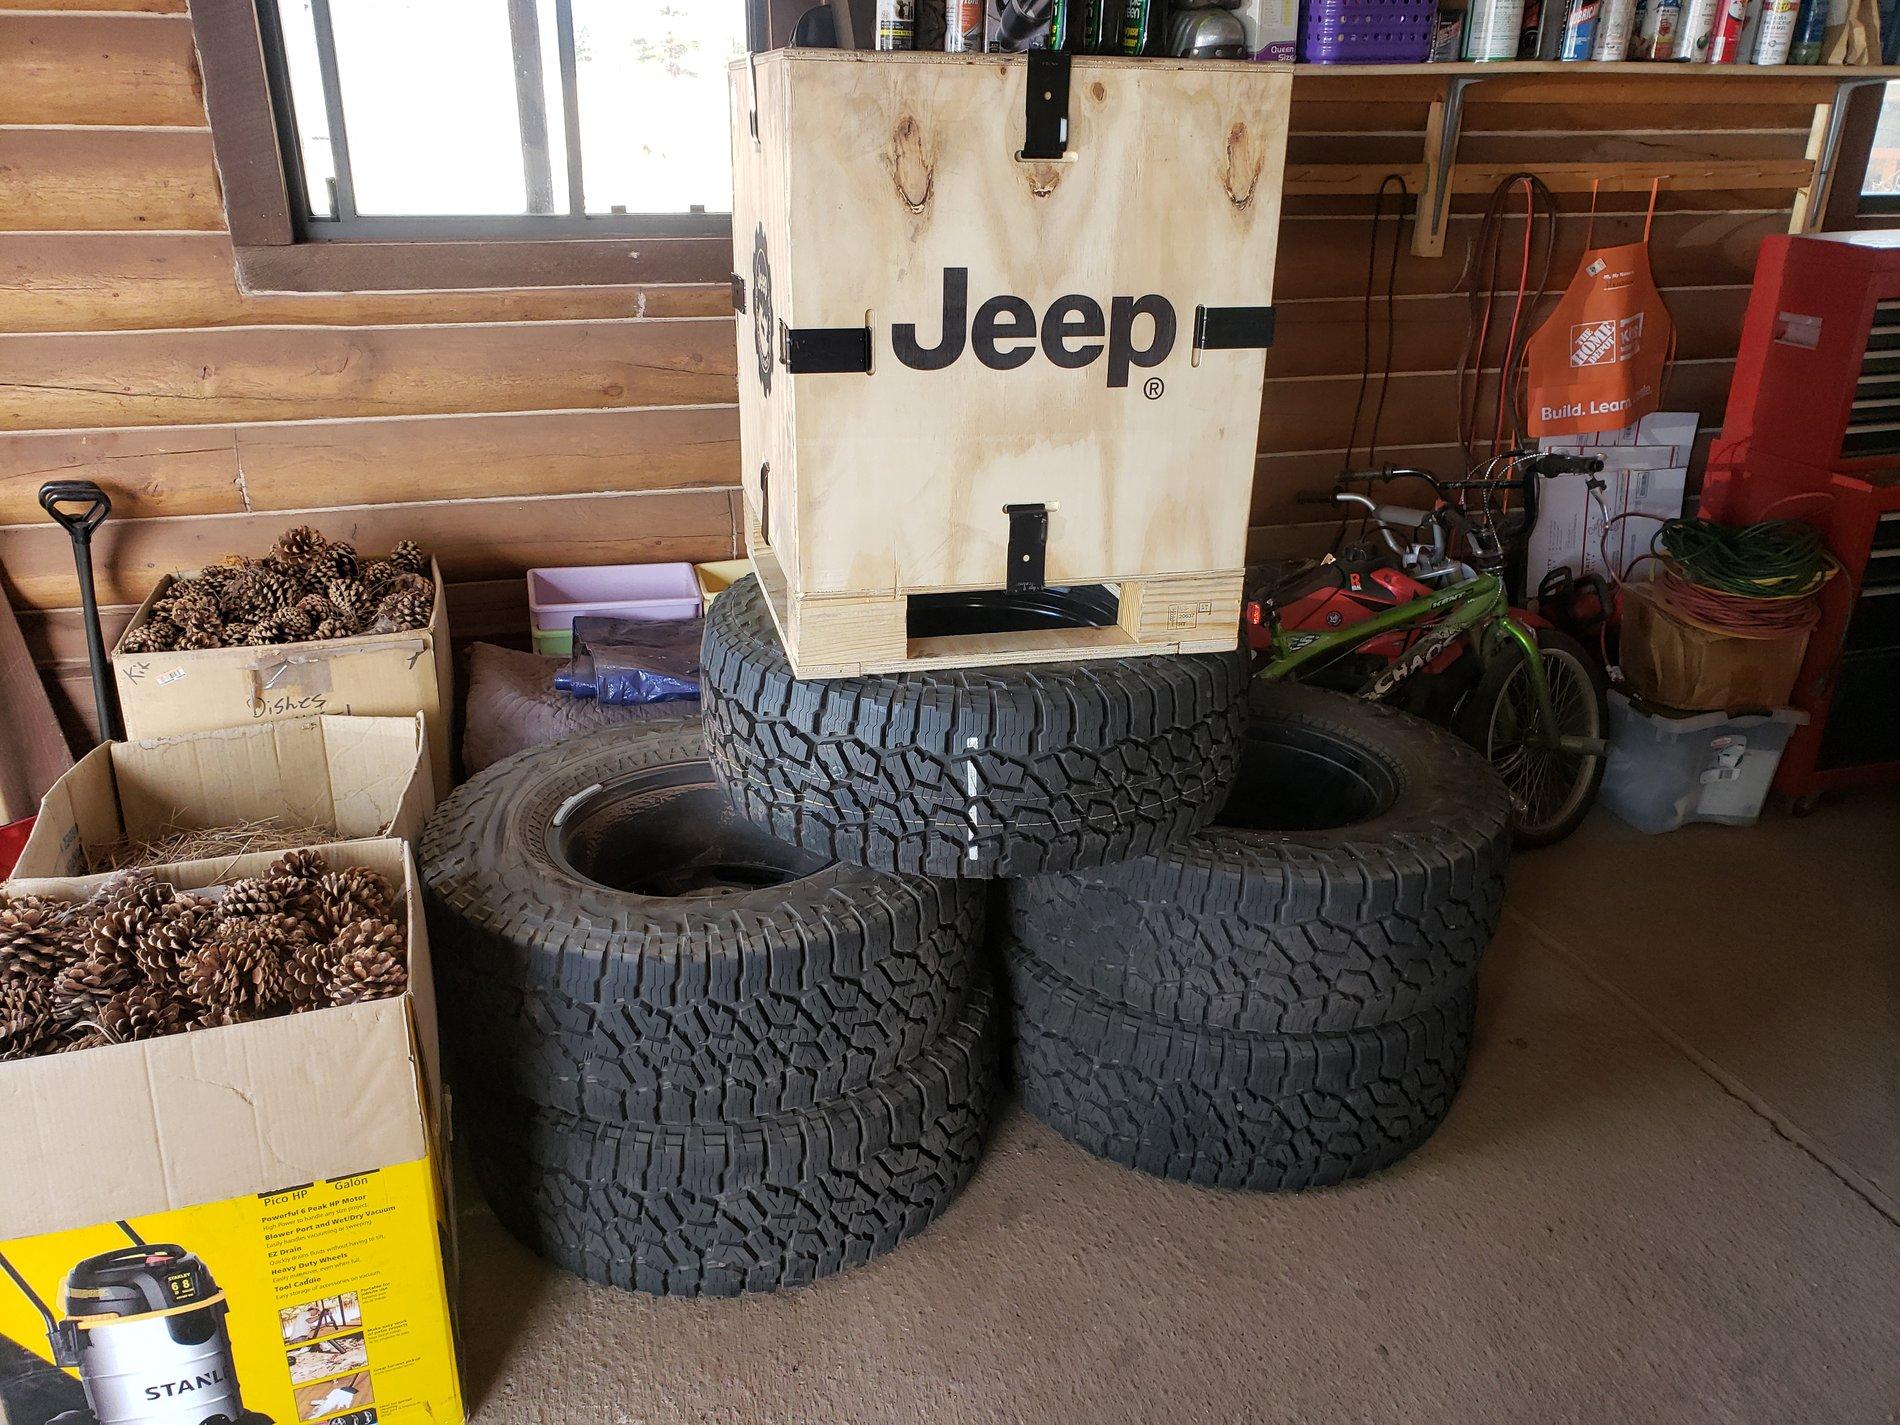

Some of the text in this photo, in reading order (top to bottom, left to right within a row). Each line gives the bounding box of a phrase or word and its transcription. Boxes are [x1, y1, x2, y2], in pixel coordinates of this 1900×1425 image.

[892, 266, 1177, 388] Jeep
[1575, 327, 1593, 345] THE
[1571, 321, 1615, 366] HOME
[1587, 336, 1614, 365] DEPOT
[1541, 402, 1586, 421] Build.
[334, 1176, 368, 1190] Galón
[264, 1190, 307, 1207] Pico HP
[262, 1210, 298, 1223] Powerful
[308, 1204, 327, 1212] Peak
[342, 1195, 366, 1204] Motor
[265, 1206, 395, 1240] Blower Port and Wet/Dry Vacuum
[280, 1246, 302, 1255] Drain
[272, 1266, 296, 1275] Heavy
[319, 1253, 347, 1263] Wheels
[171, 1279, 190, 1291] 6 8
[275, 1277, 321, 1292] Tool Caddie
